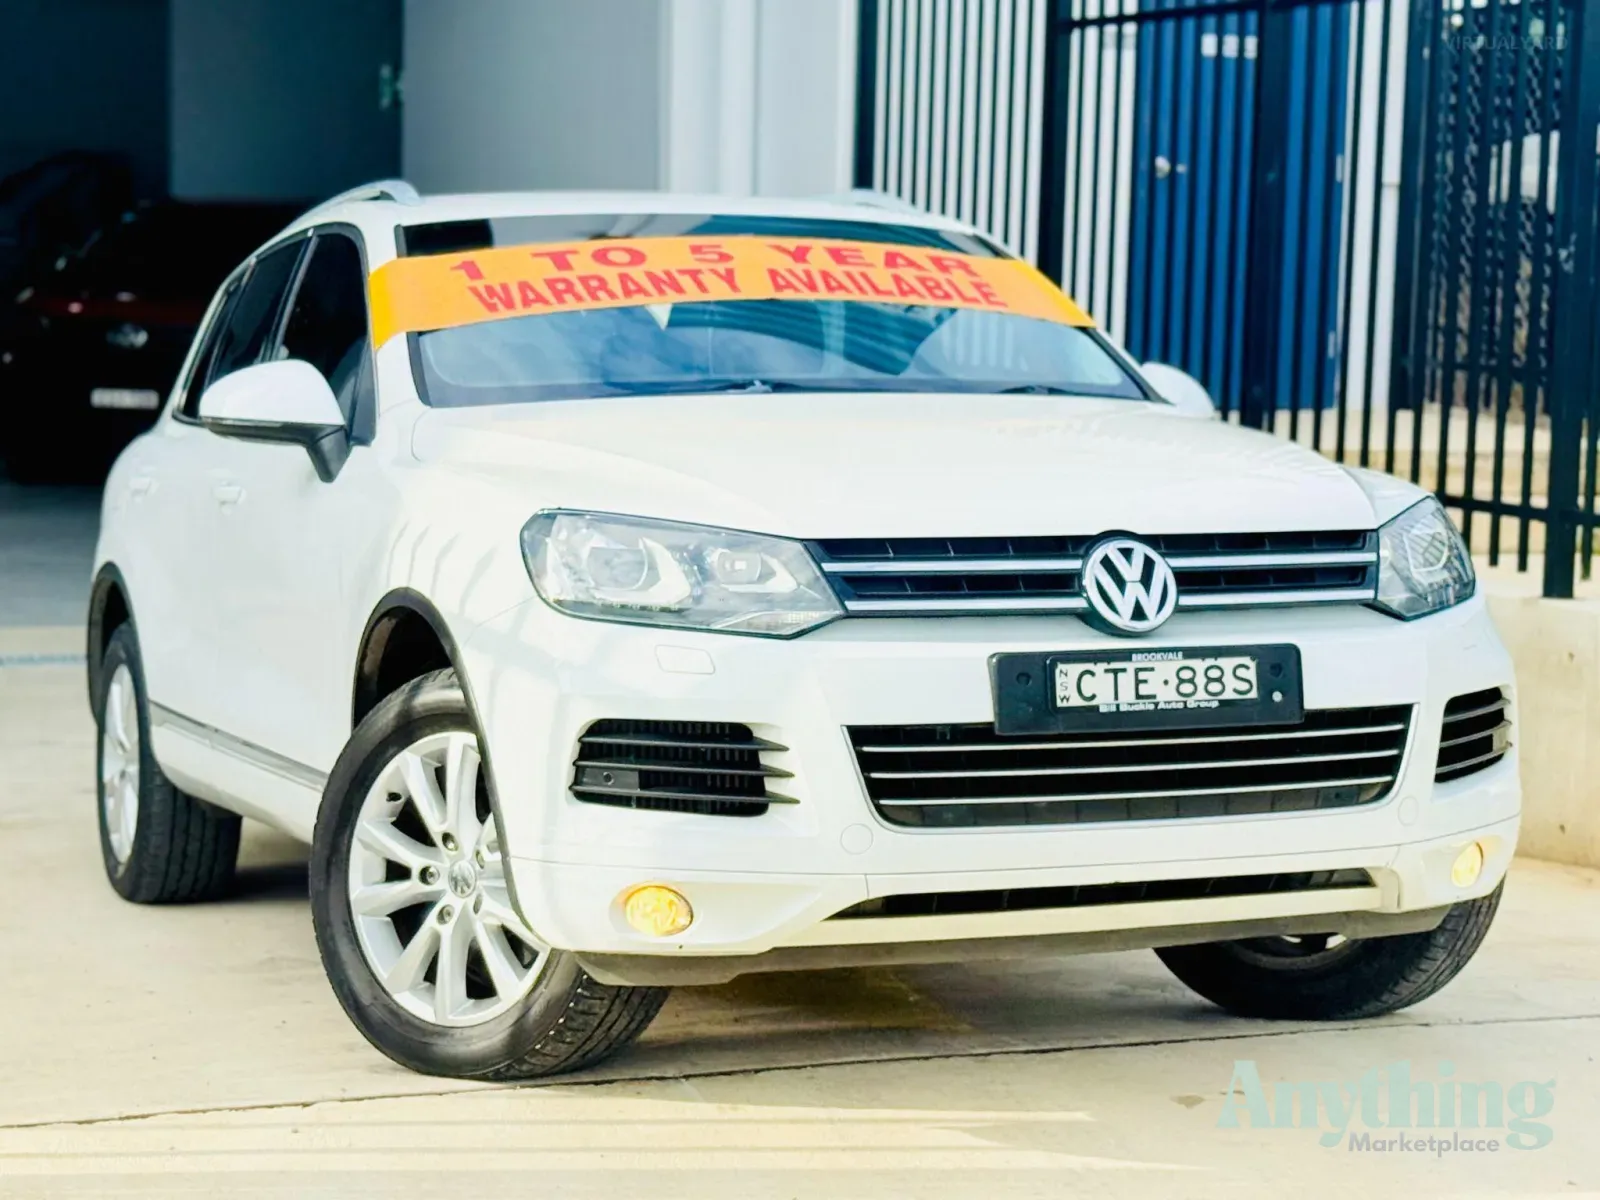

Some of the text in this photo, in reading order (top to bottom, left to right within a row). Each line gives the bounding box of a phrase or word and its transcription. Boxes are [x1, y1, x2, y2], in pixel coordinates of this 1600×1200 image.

[450, 244, 982, 281] 1 TO 5 YEAR
[466, 267, 1009, 314] WARRANTY AVAILABLE
[1086, 541, 1174, 629] VW
[1131, 650, 1184, 662] BROOKVALE
[1058, 668, 1071, 704] NSW
[1099, 702, 1117, 713] Bill
[1157, 700, 1185, 710] Auto
[1186, 699, 1220, 709] Group
